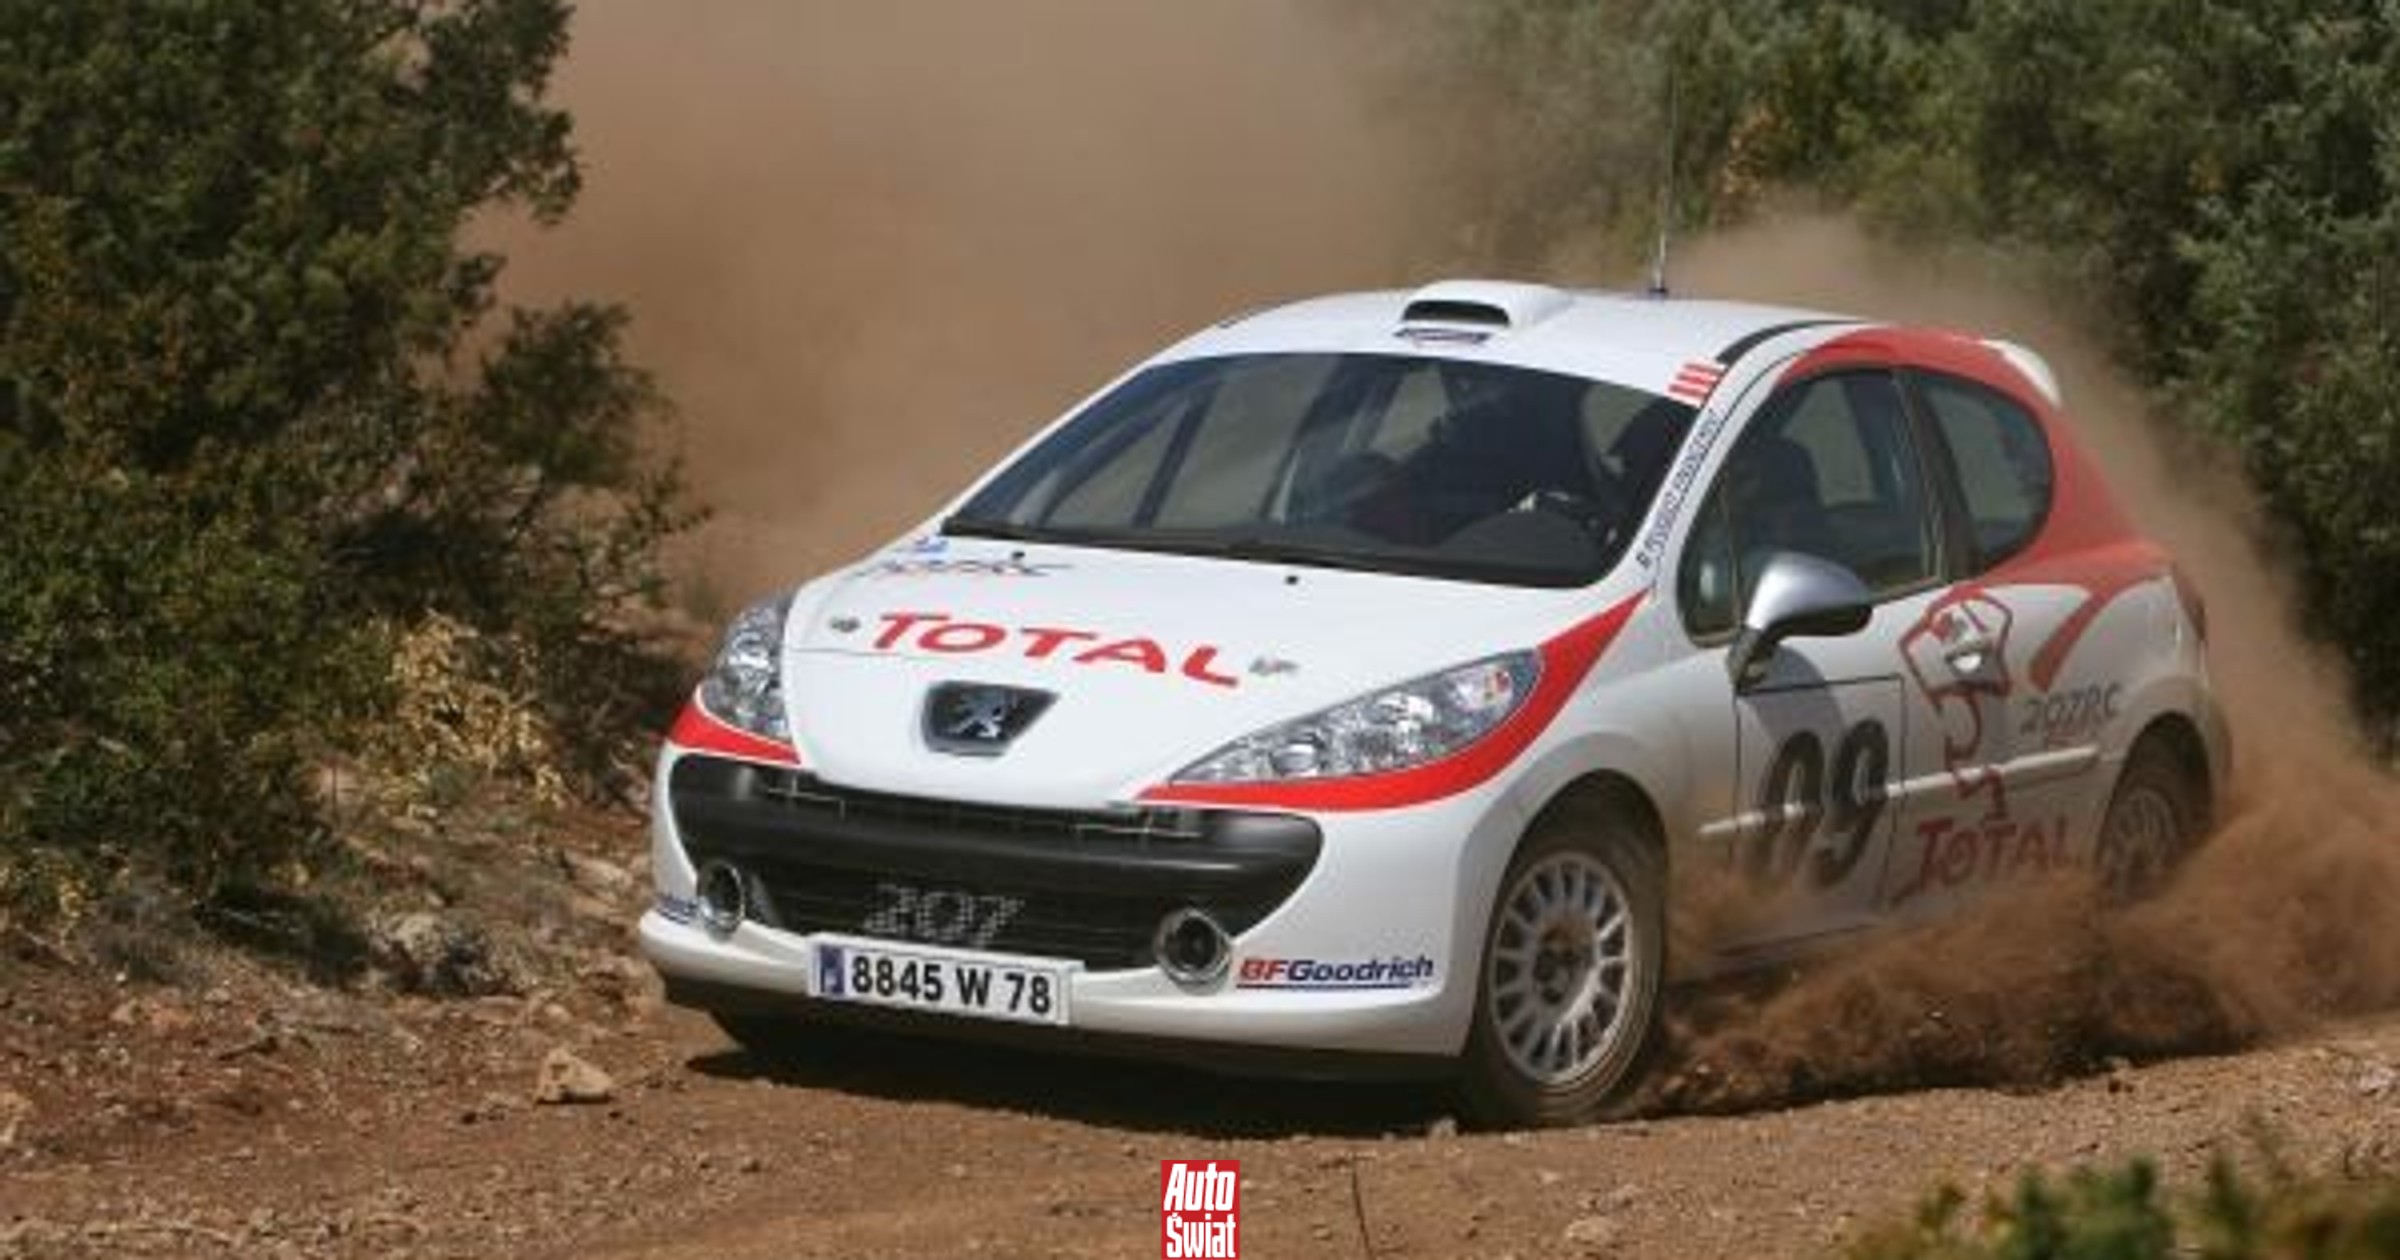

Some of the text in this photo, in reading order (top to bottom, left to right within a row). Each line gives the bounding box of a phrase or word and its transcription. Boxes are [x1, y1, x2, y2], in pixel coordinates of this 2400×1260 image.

[873, 611, 1239, 689] TOTAL
[1757, 717, 1890, 886] 09
[1917, 814, 2085, 890] TOTAL
[863, 882, 1026, 950] 207
[852, 955, 1050, 1014] 8845 W 78
[1240, 955, 1433, 981] BFGoodrich
